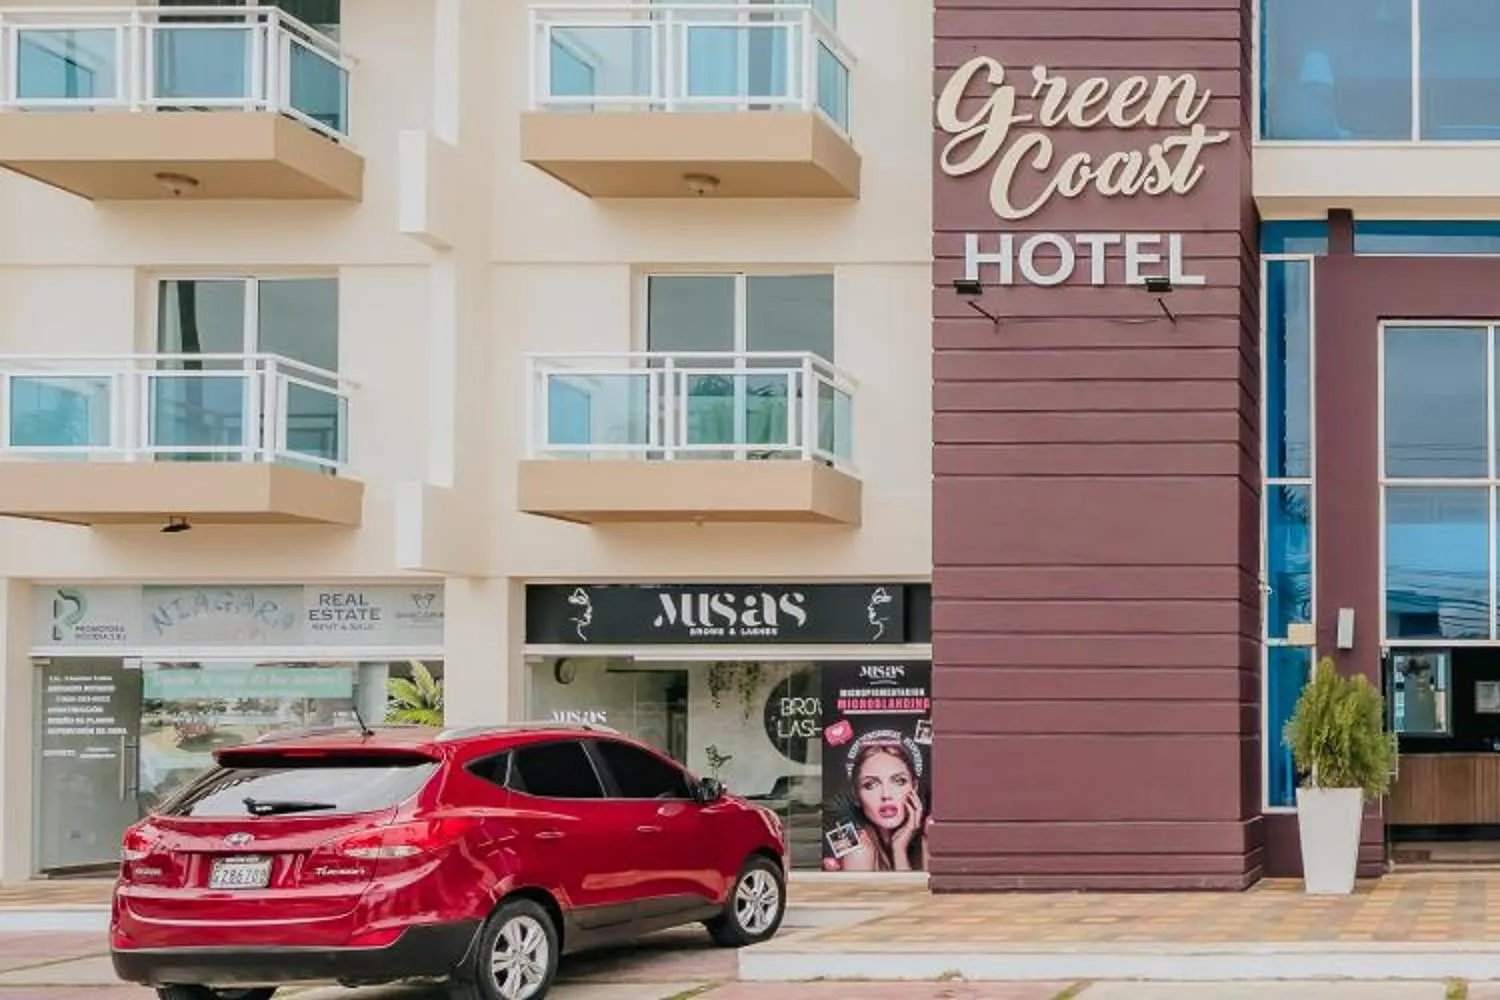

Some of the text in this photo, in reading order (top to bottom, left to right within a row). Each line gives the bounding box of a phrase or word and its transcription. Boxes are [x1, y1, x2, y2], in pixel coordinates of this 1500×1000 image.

[937, 56, 1211, 176] Green
[989, 124, 1230, 219] Coast
[965, 233, 1206, 286] HOTEL
[308, 608, 381, 621] ESTATE
[319, 593, 369, 606] REAL
[780, 697, 823, 716] BRO
